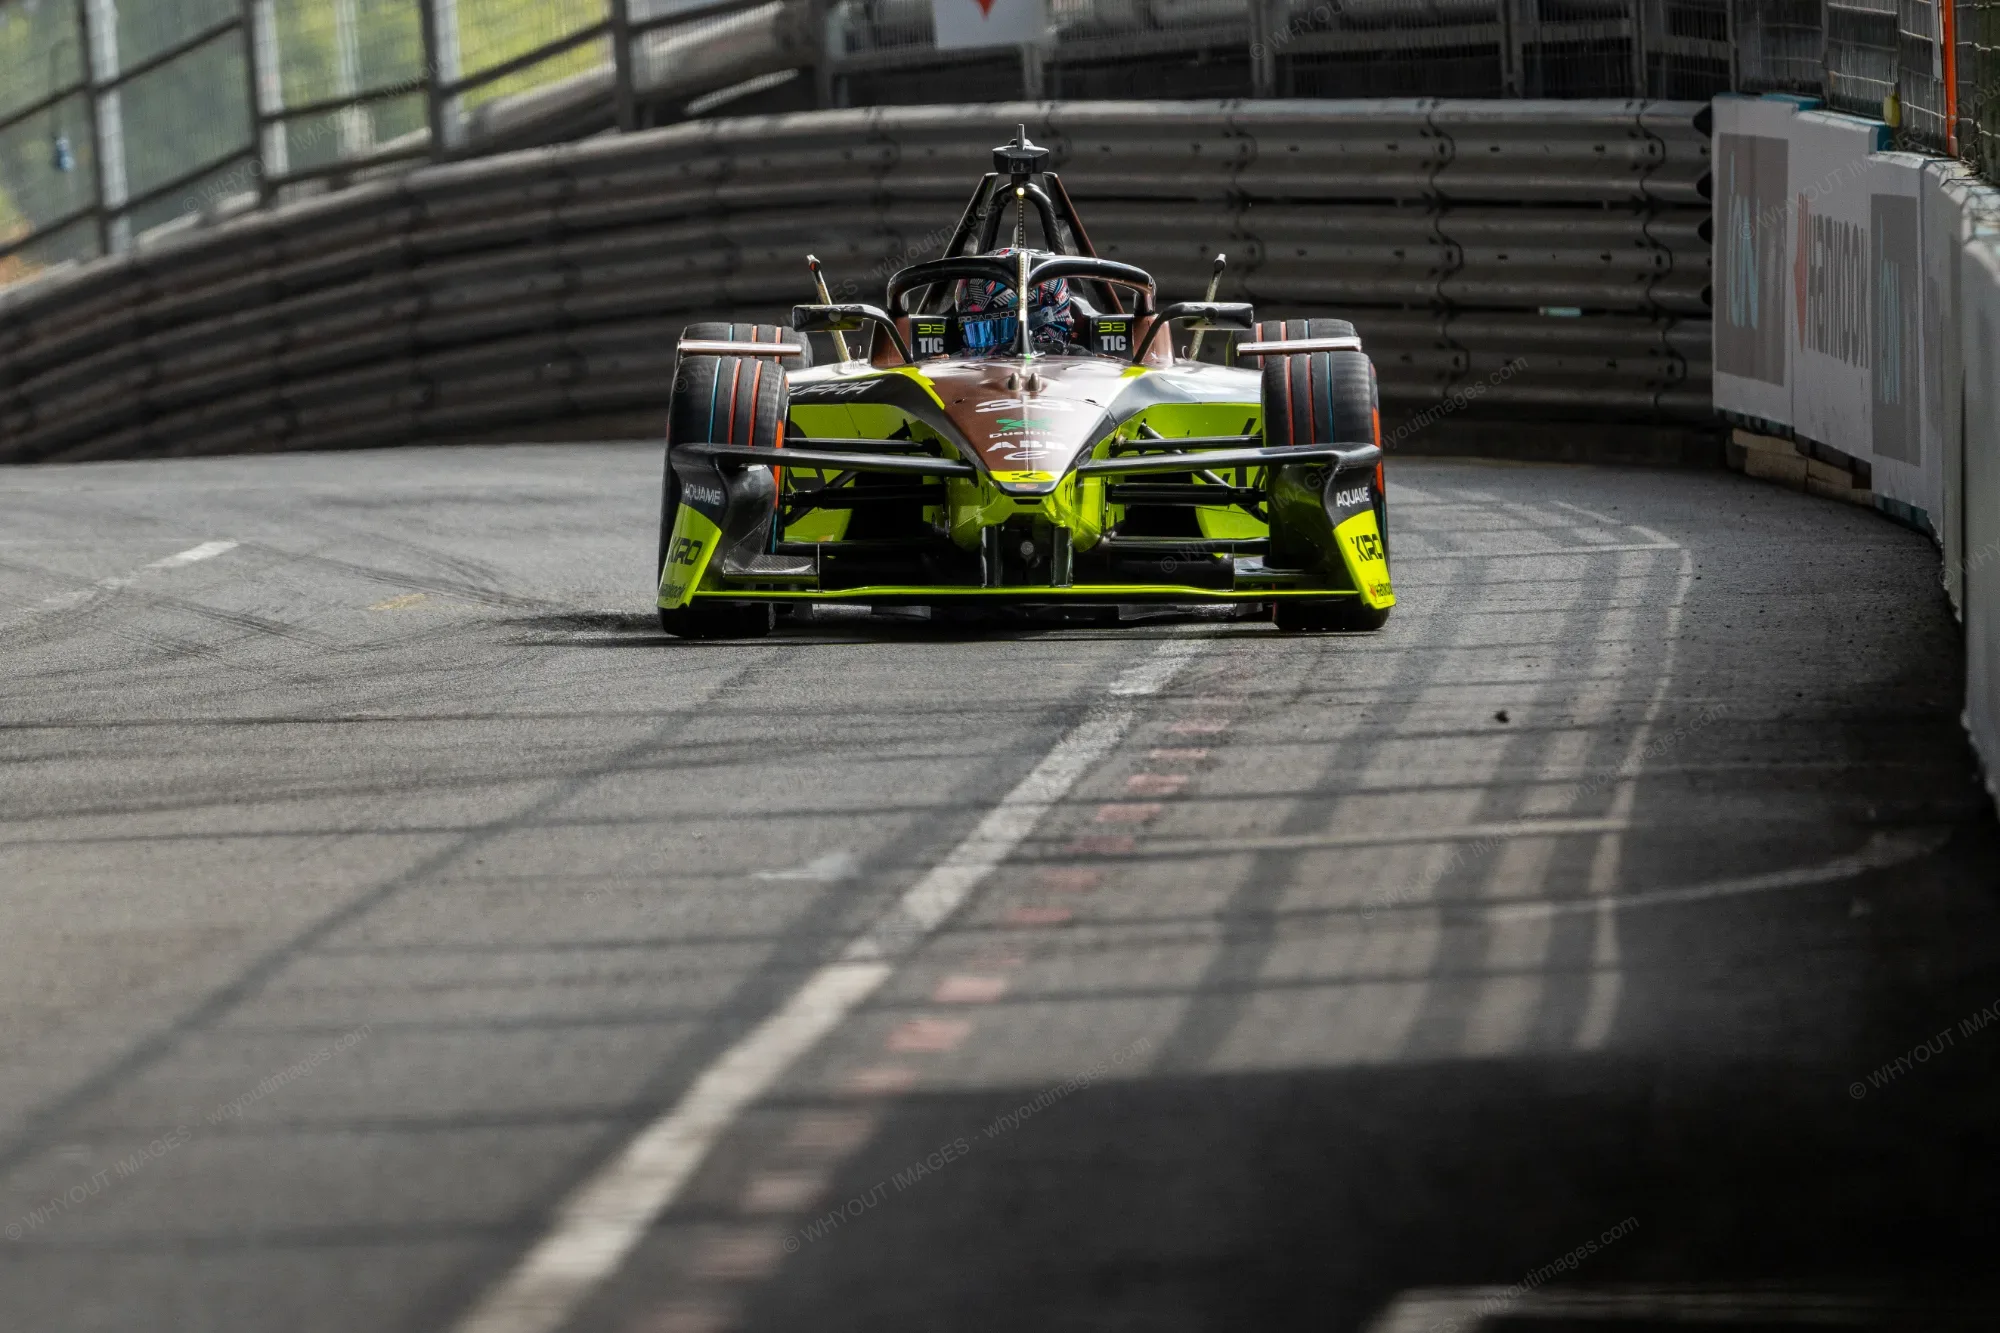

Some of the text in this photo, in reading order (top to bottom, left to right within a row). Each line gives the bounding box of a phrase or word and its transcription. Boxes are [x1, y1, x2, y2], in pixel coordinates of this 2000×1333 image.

[918, 324, 945, 334] 33
[1098, 322, 1126, 332] 33
[919, 338, 944, 353] TIC
[1100, 336, 1126, 350] TIC
